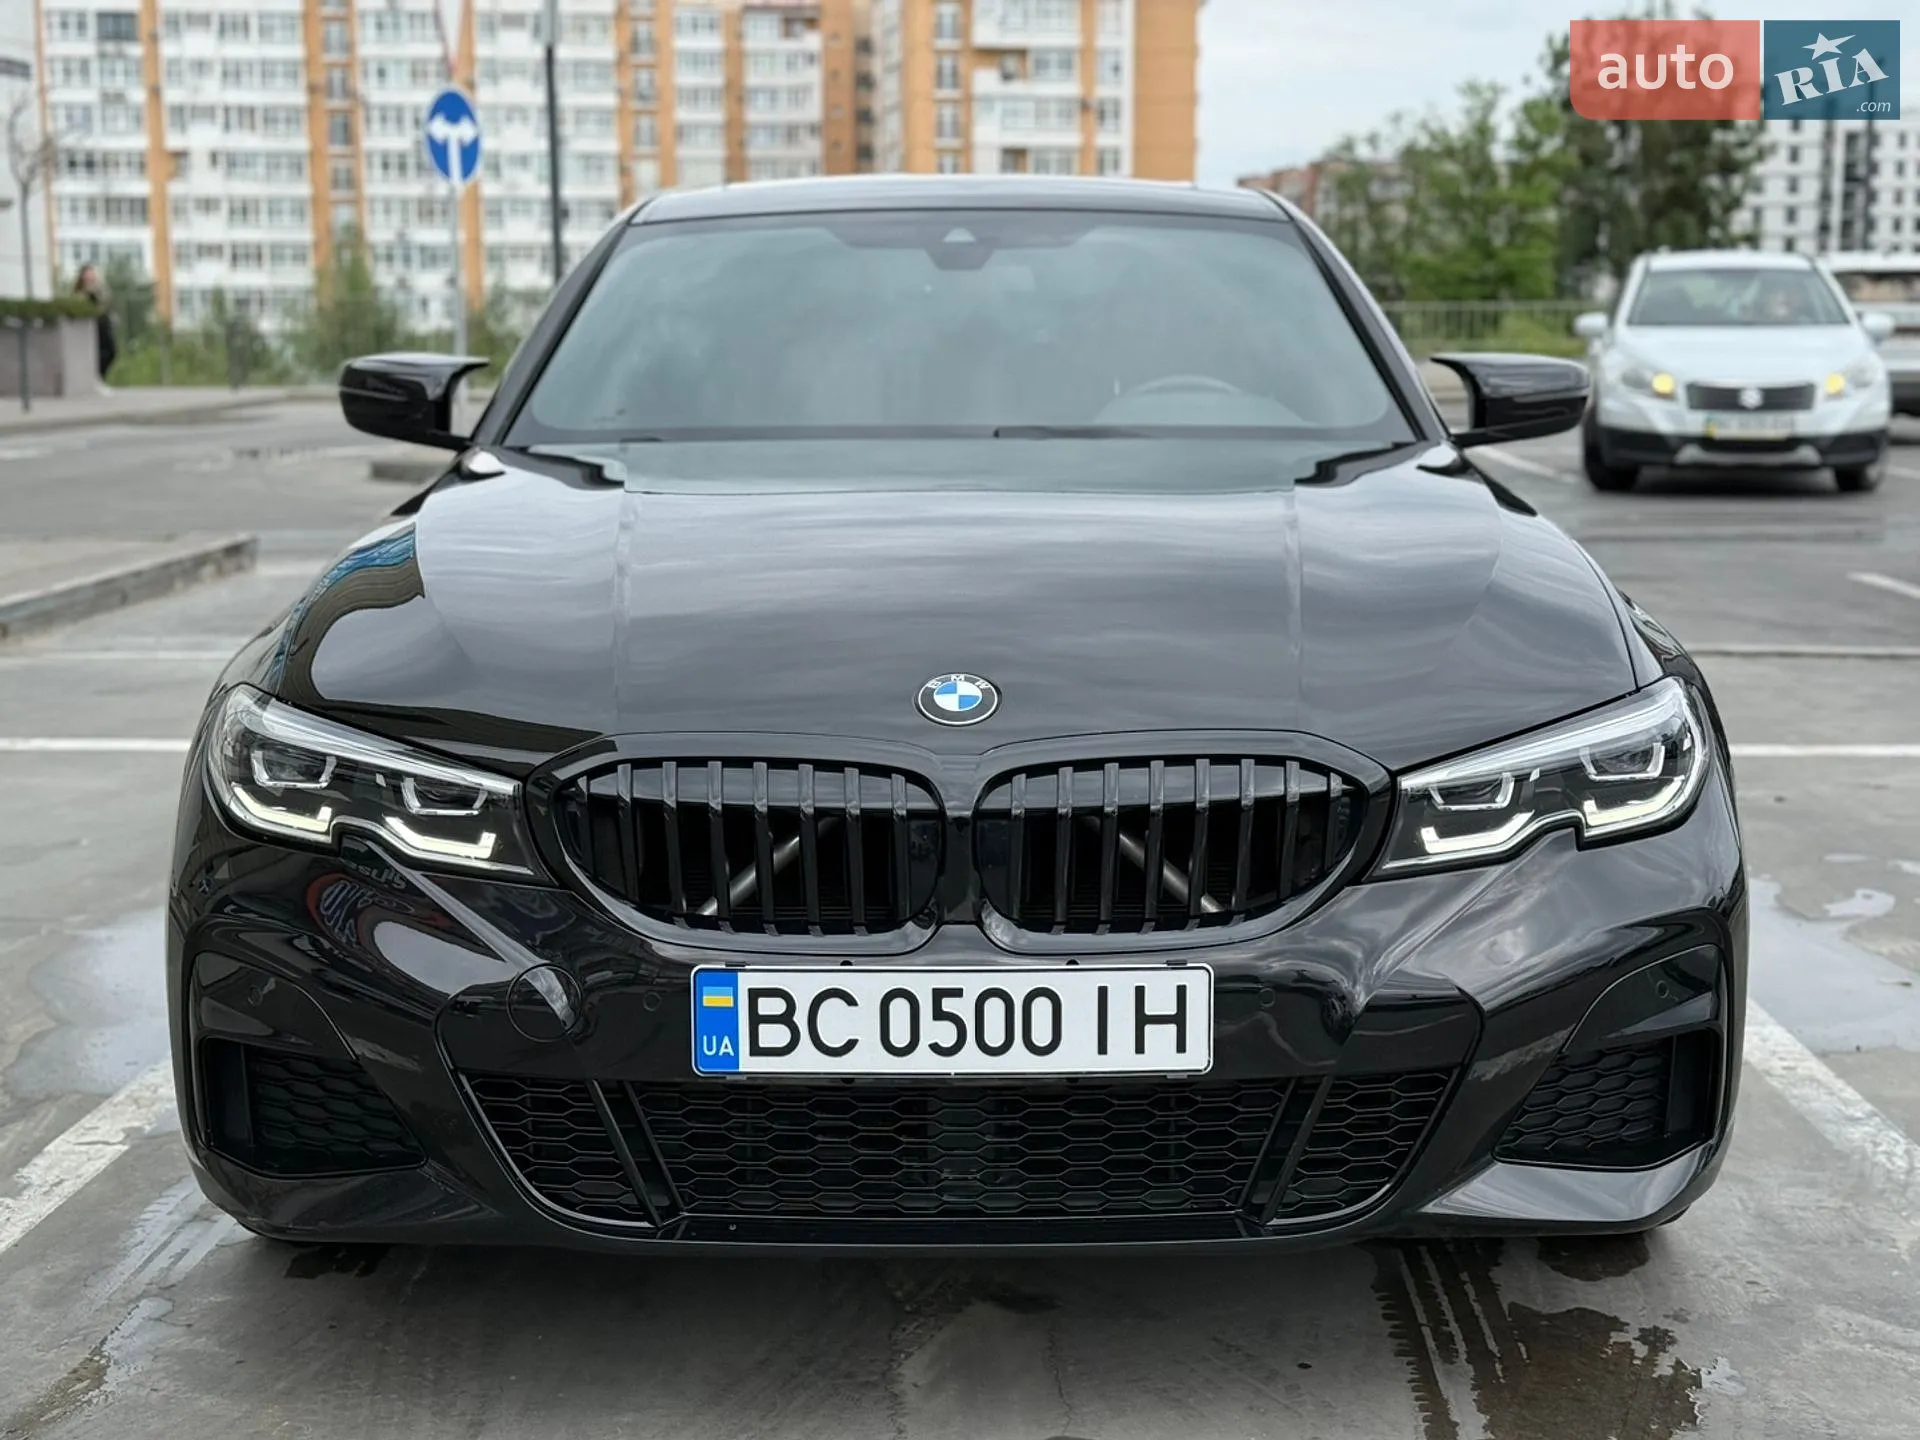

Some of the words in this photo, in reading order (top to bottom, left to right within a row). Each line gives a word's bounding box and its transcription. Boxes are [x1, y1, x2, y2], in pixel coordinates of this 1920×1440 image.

[927, 674, 992, 689] BMW
[747, 987, 860, 1058] BC
[879, 986, 1063, 1058] 0500
[1097, 985, 1187, 1056] IH
[703, 1035, 735, 1057] UA
